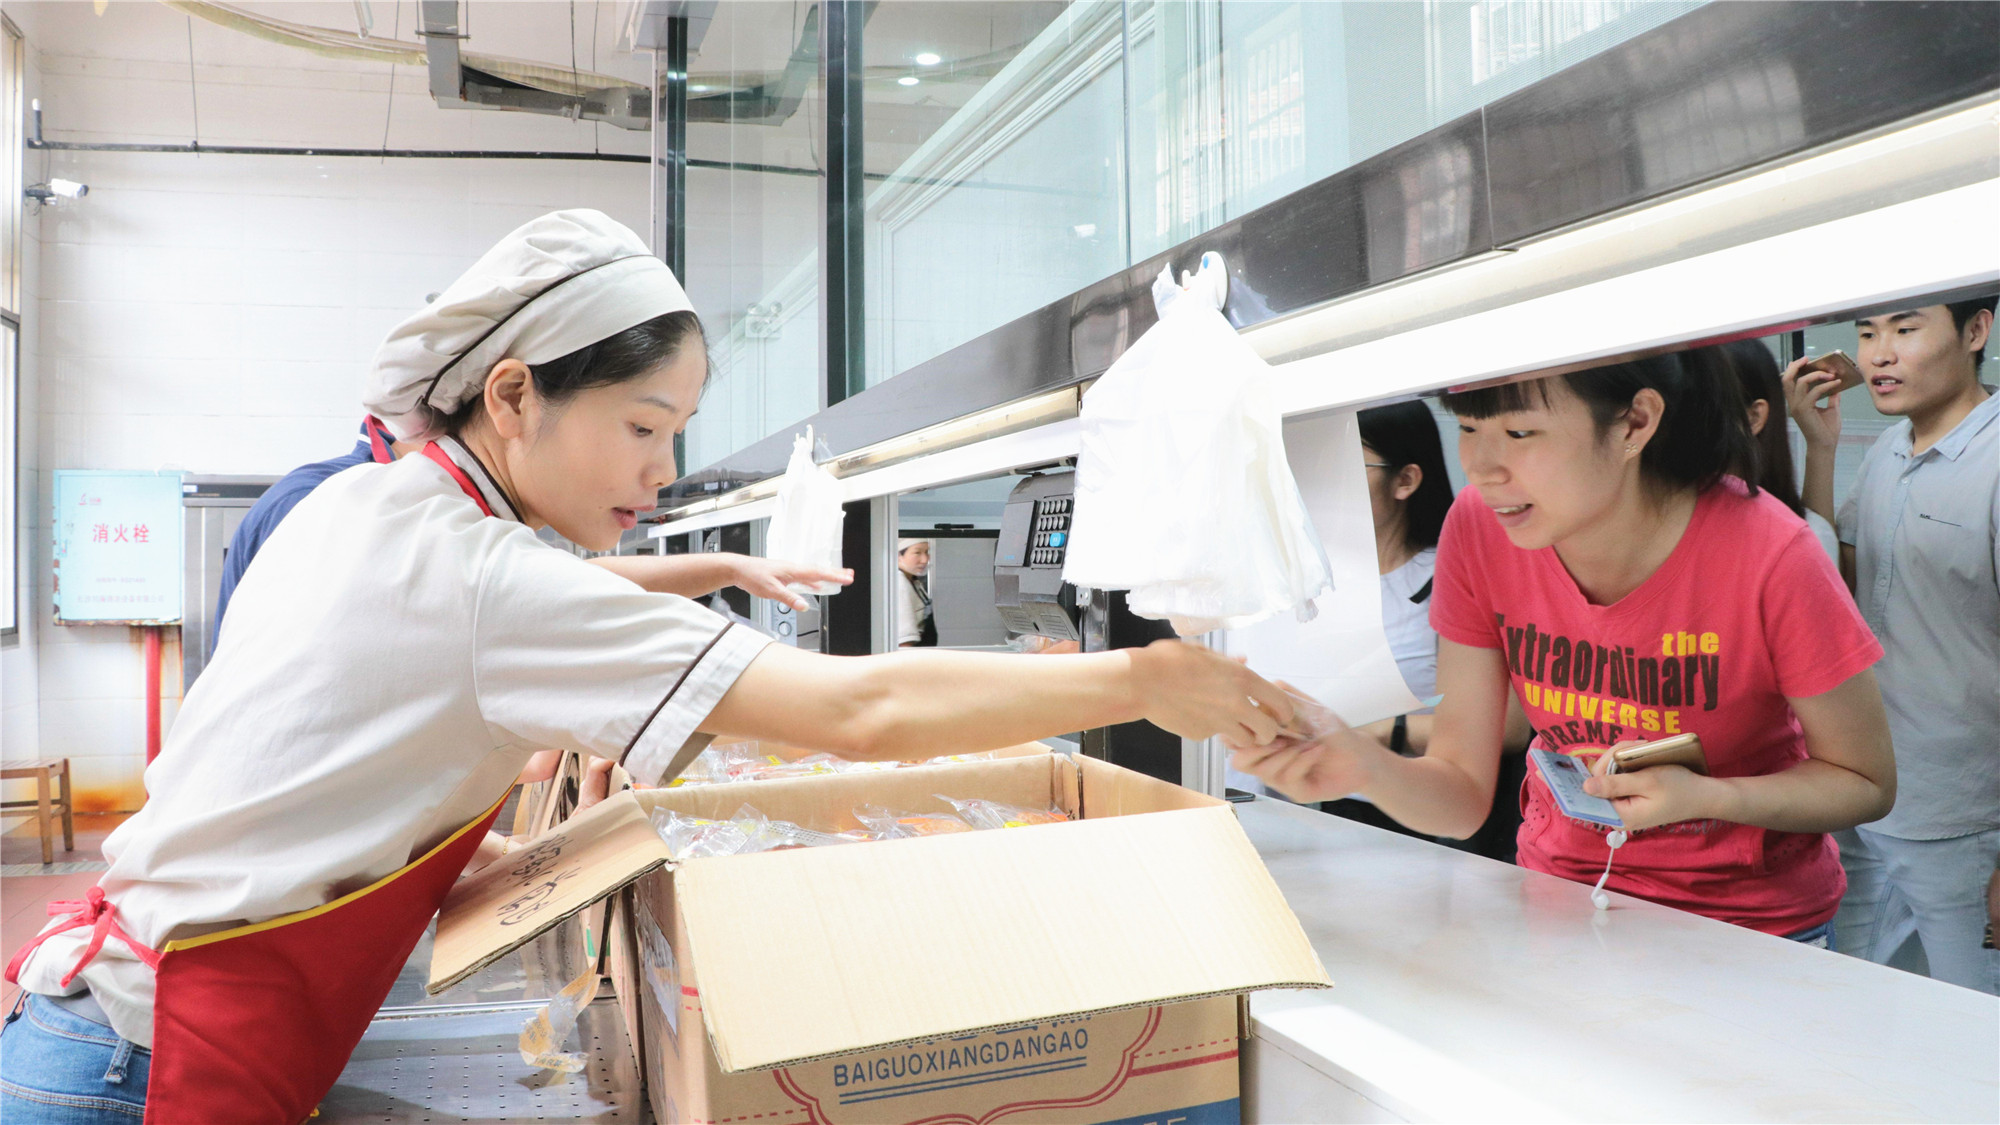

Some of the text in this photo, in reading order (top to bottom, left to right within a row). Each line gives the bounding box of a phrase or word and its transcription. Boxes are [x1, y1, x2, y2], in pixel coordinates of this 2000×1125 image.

[92, 523, 150, 543] 消火栓
[1662, 631, 1720, 657] the
[1524, 682, 1681, 734] UNIVERSE
[834, 1028, 1088, 1088] BAIGUOXIANGDANGAO
